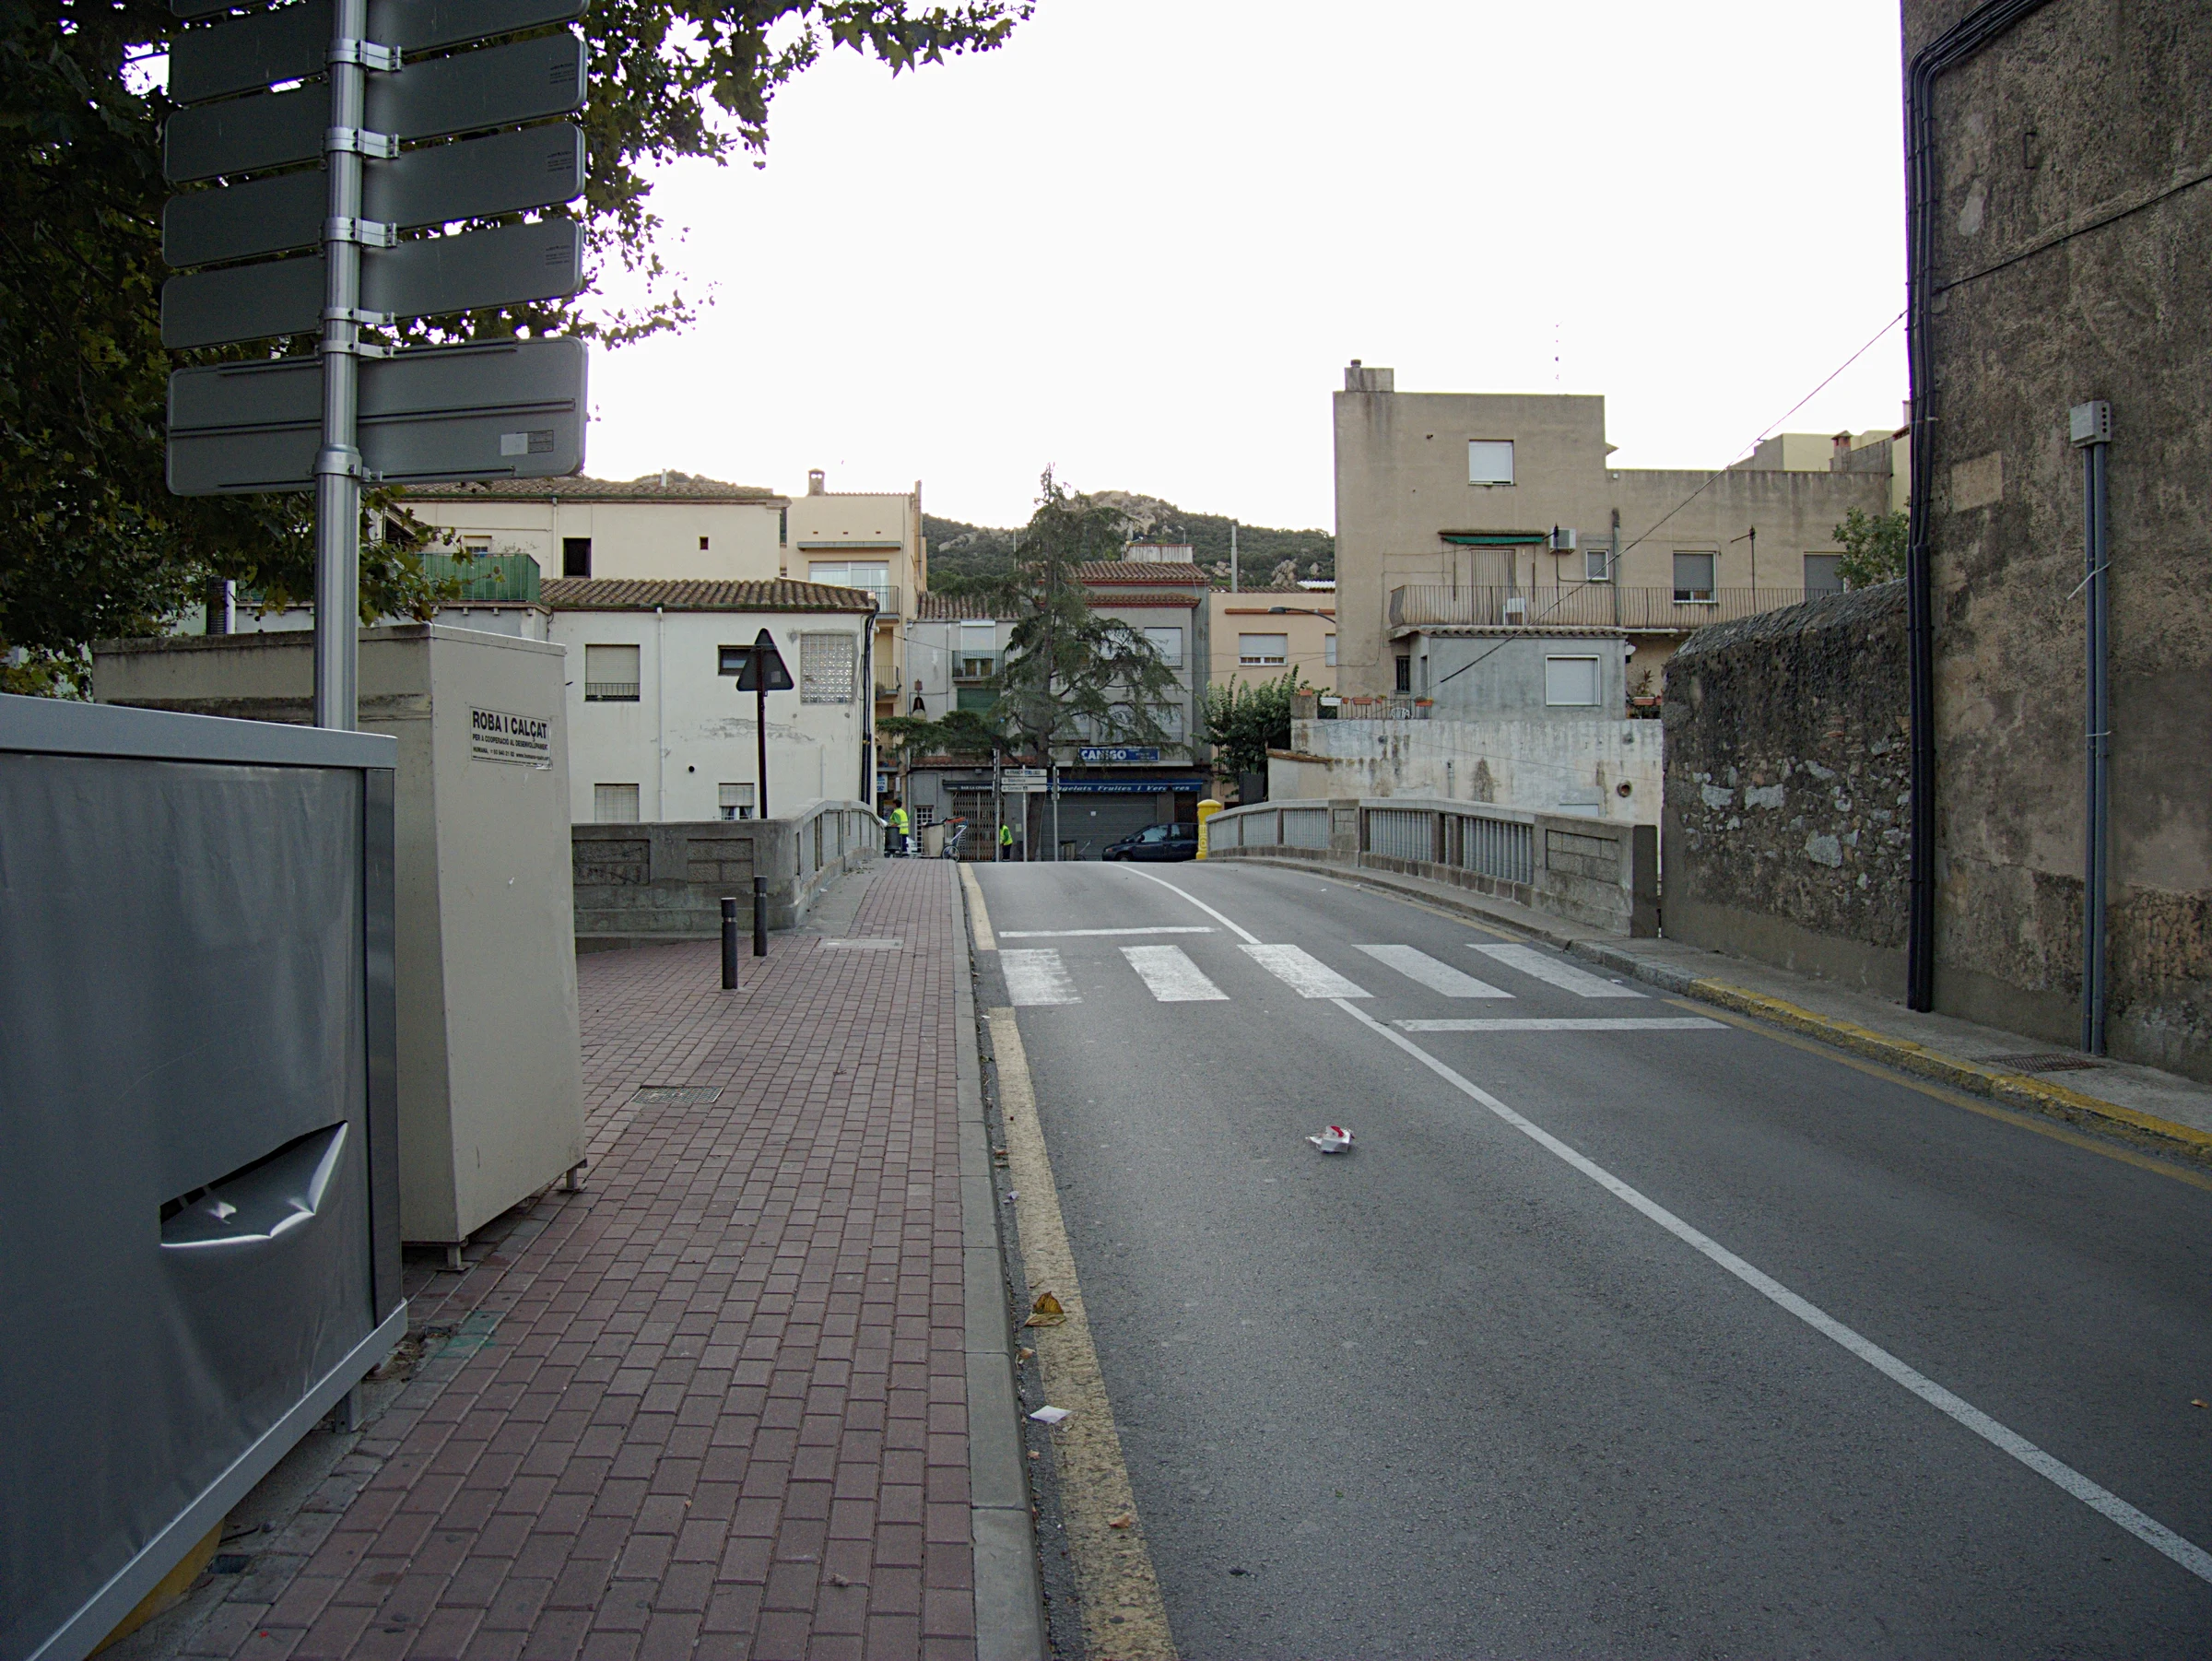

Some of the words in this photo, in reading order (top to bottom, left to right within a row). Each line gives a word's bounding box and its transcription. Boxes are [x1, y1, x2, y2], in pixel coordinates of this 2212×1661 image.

[472, 711, 502, 732] ROBA
[504, 717, 508, 733] I
[511, 718, 547, 743] CALÇAT
[510, 738, 515, 747] AL
